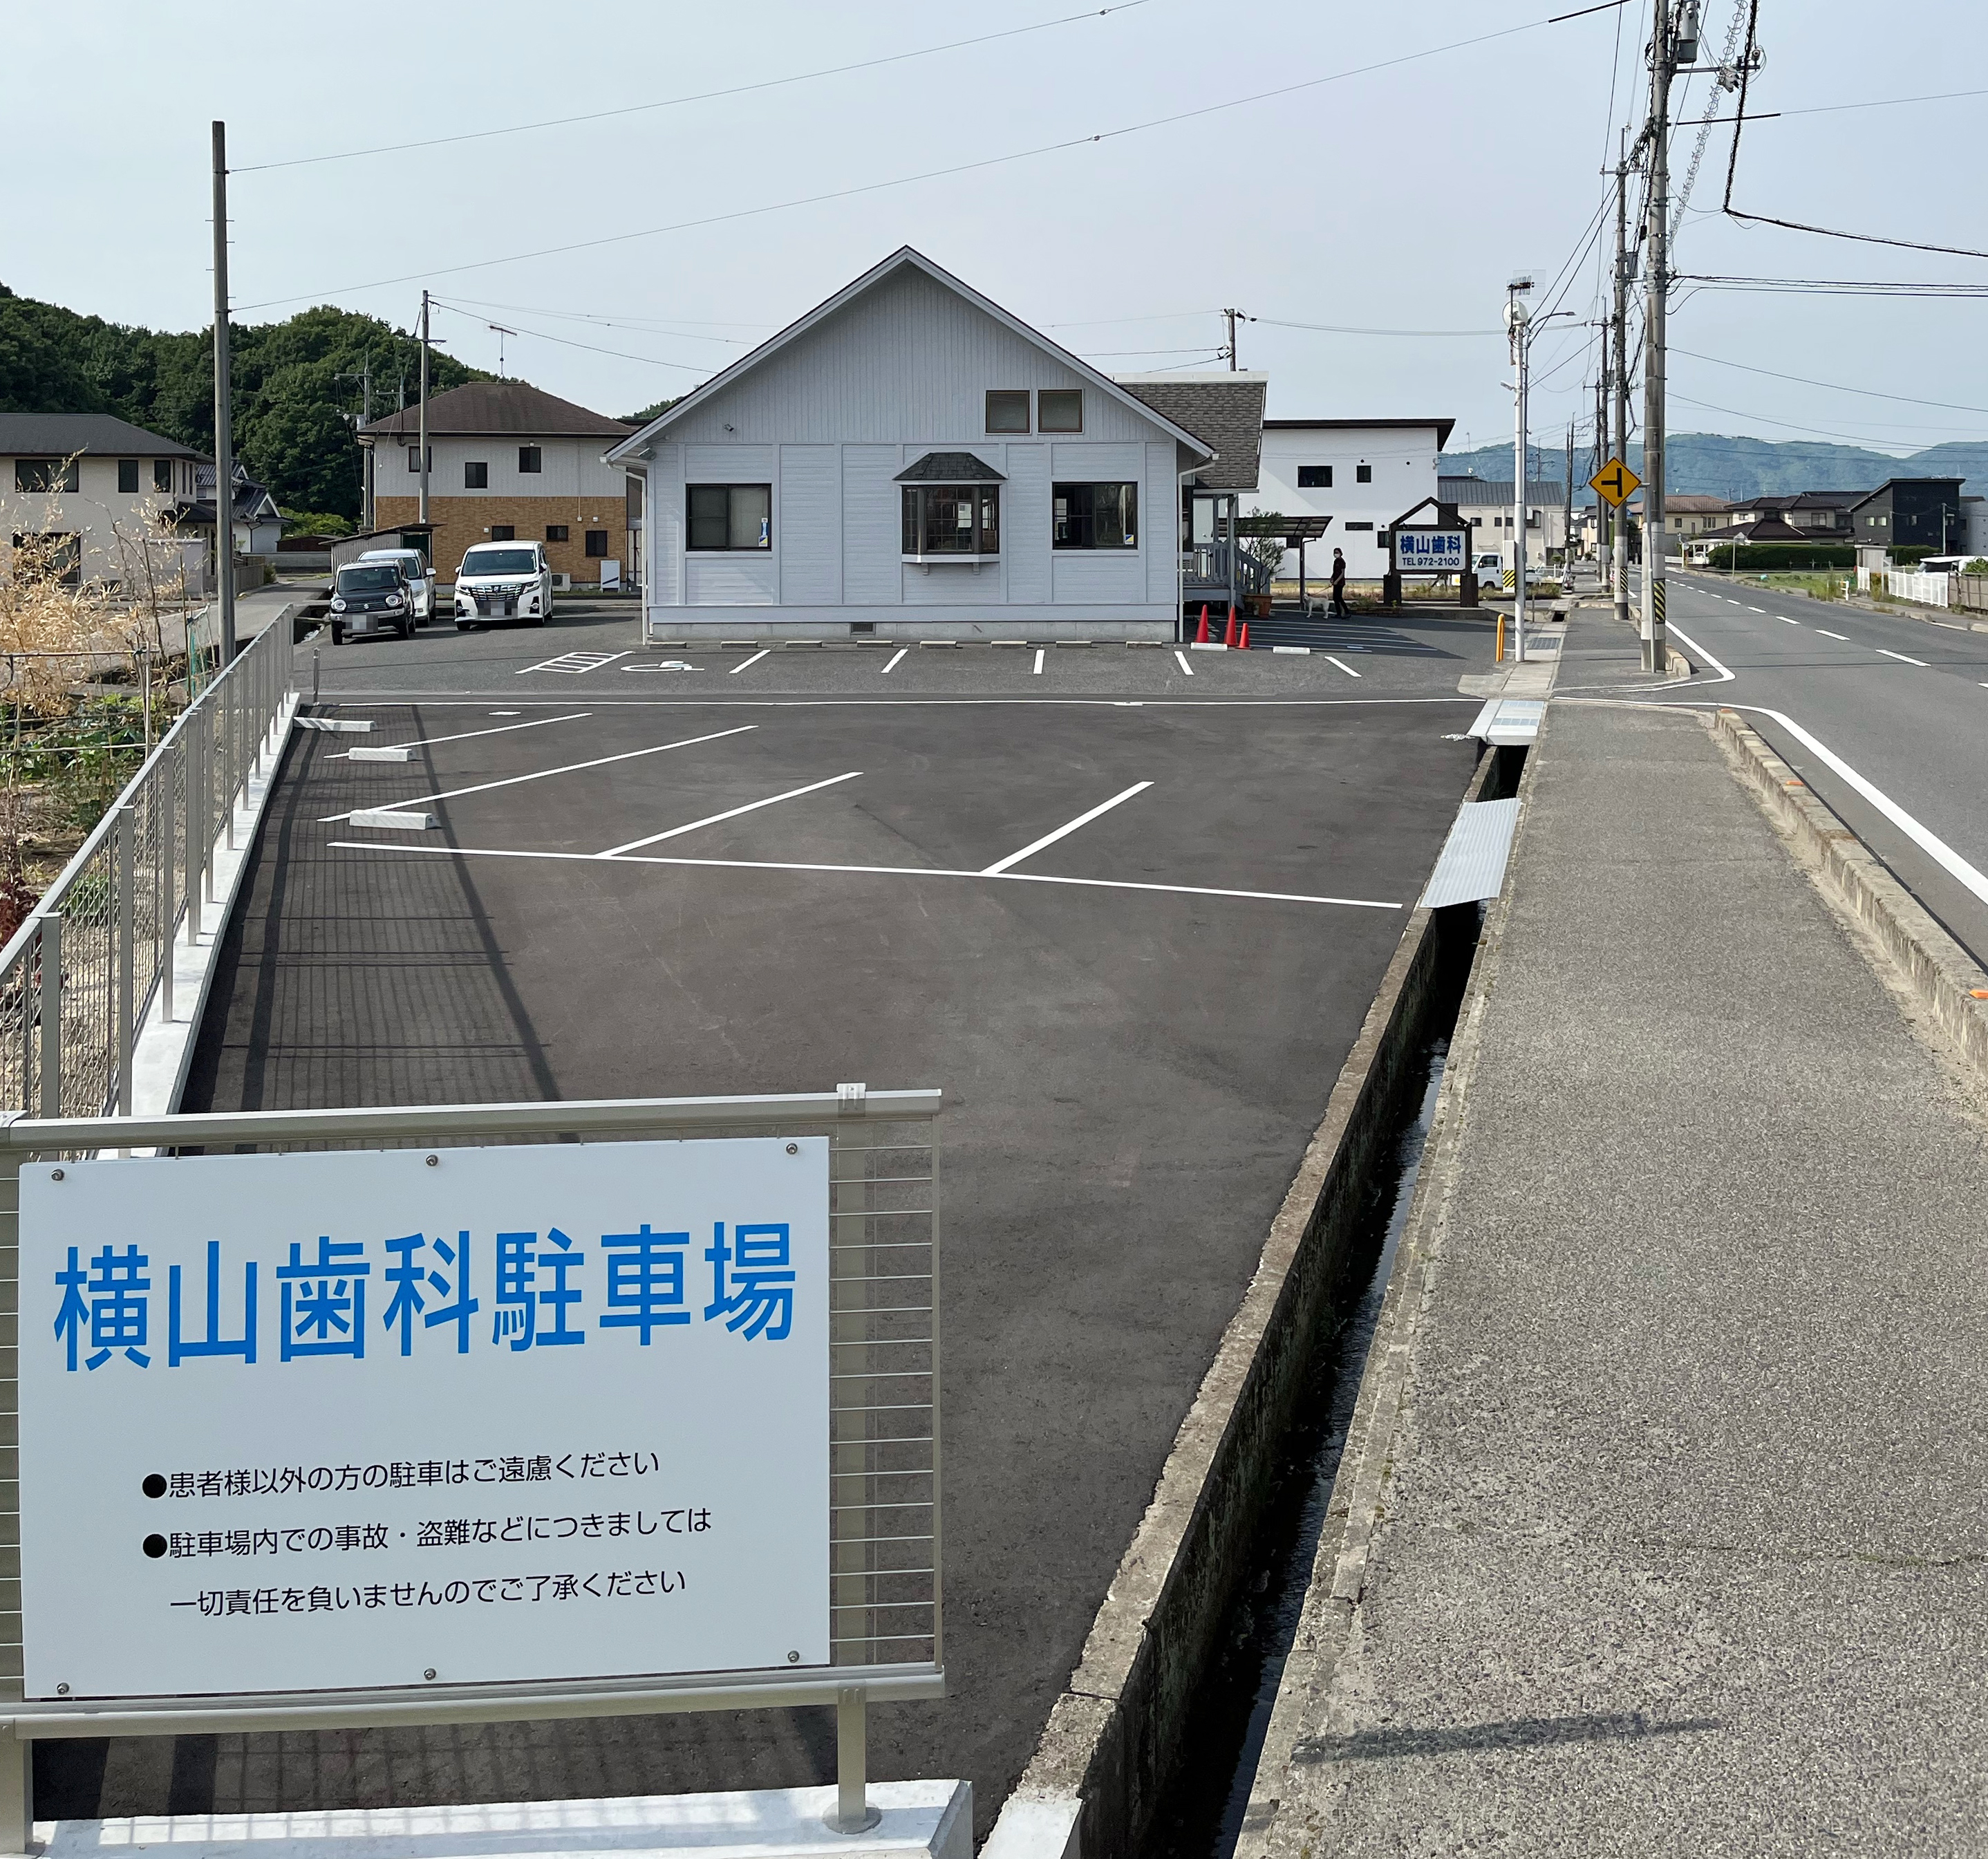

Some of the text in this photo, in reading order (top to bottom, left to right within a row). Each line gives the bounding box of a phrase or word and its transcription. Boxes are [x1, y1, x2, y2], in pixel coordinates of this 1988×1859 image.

[1400, 535, 1461, 554] 横山歯科
[1402, 557, 1460, 566] TEL 972-2100
[53, 1221, 796, 1372] 横山歯科駐車場
[168, 1451, 659, 1499] 患者様以外の方の駐車はご遠慮ください
[169, 1507, 711, 1559] 駐車場内での事故・盗難などにつきましては
[169, 1570, 685, 1616] 一切責任を負いませんのでご了承ください
